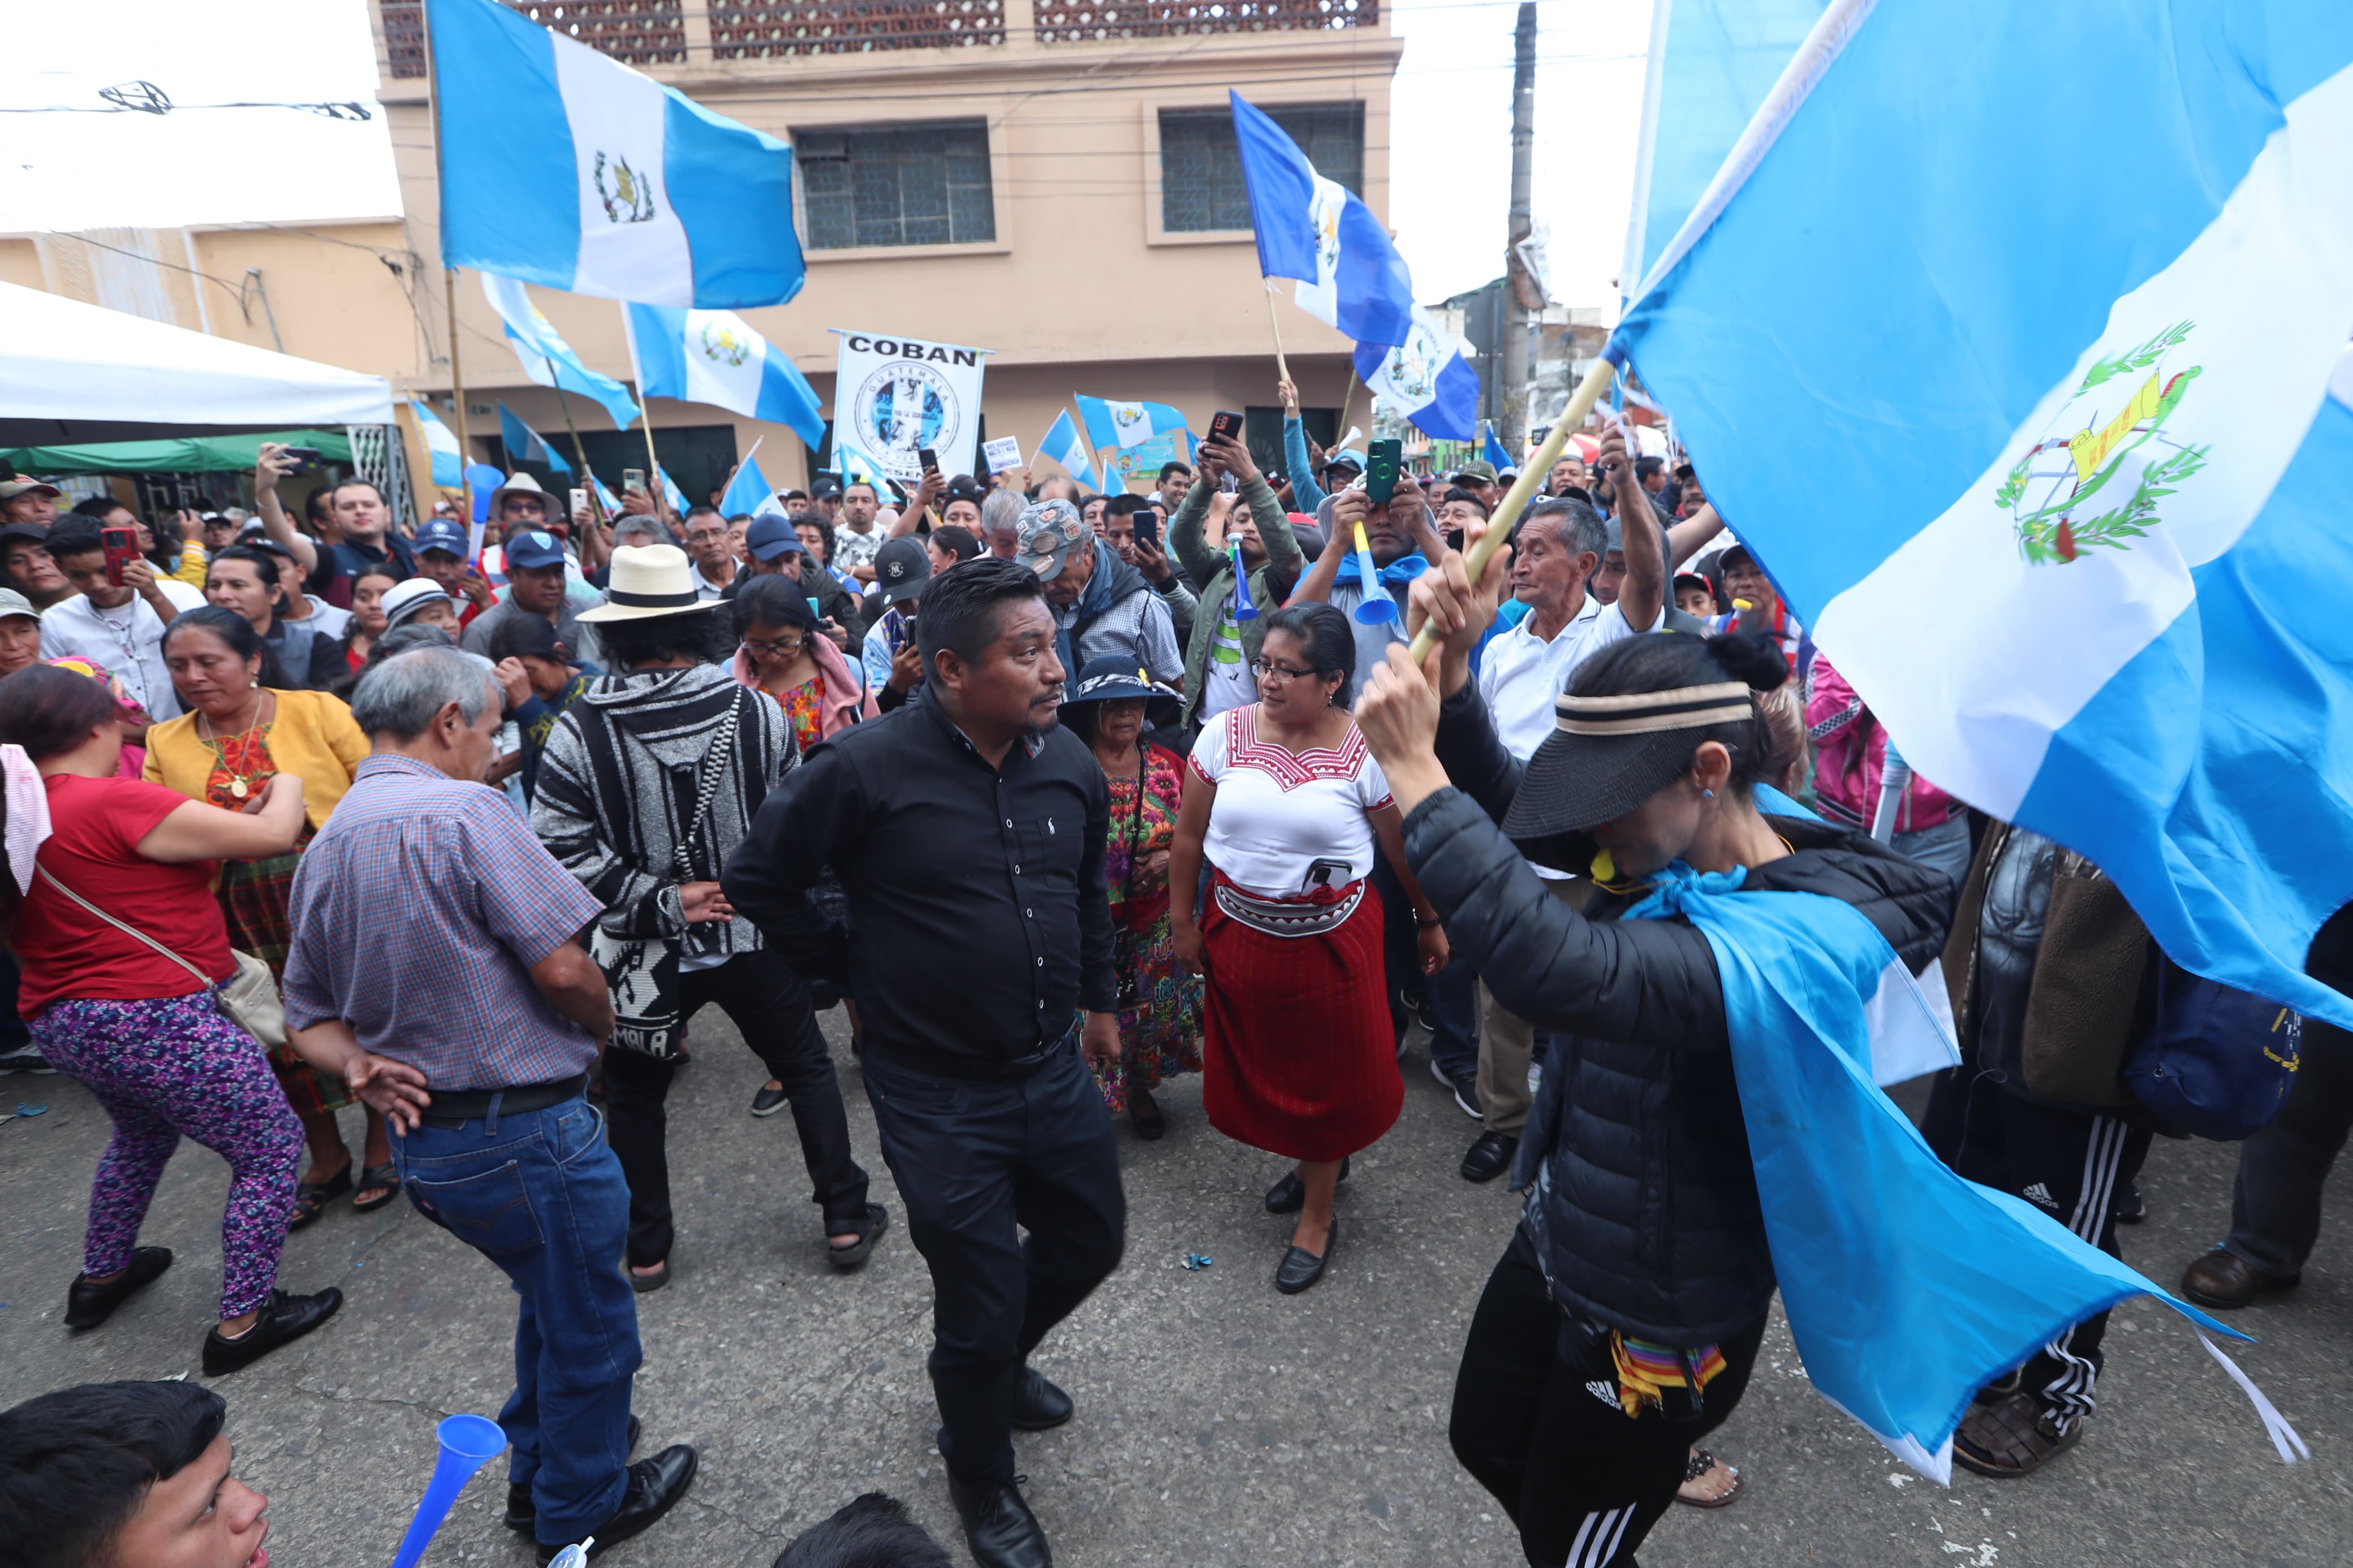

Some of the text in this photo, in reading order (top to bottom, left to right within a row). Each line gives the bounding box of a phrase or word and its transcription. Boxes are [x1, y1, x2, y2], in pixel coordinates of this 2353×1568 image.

[848, 336, 976, 367] COBAN
[869, 368, 949, 401] GUATEMALA
[2023, 1188, 2059, 1209] adidas
[1585, 1382, 1622, 1411] adidas
